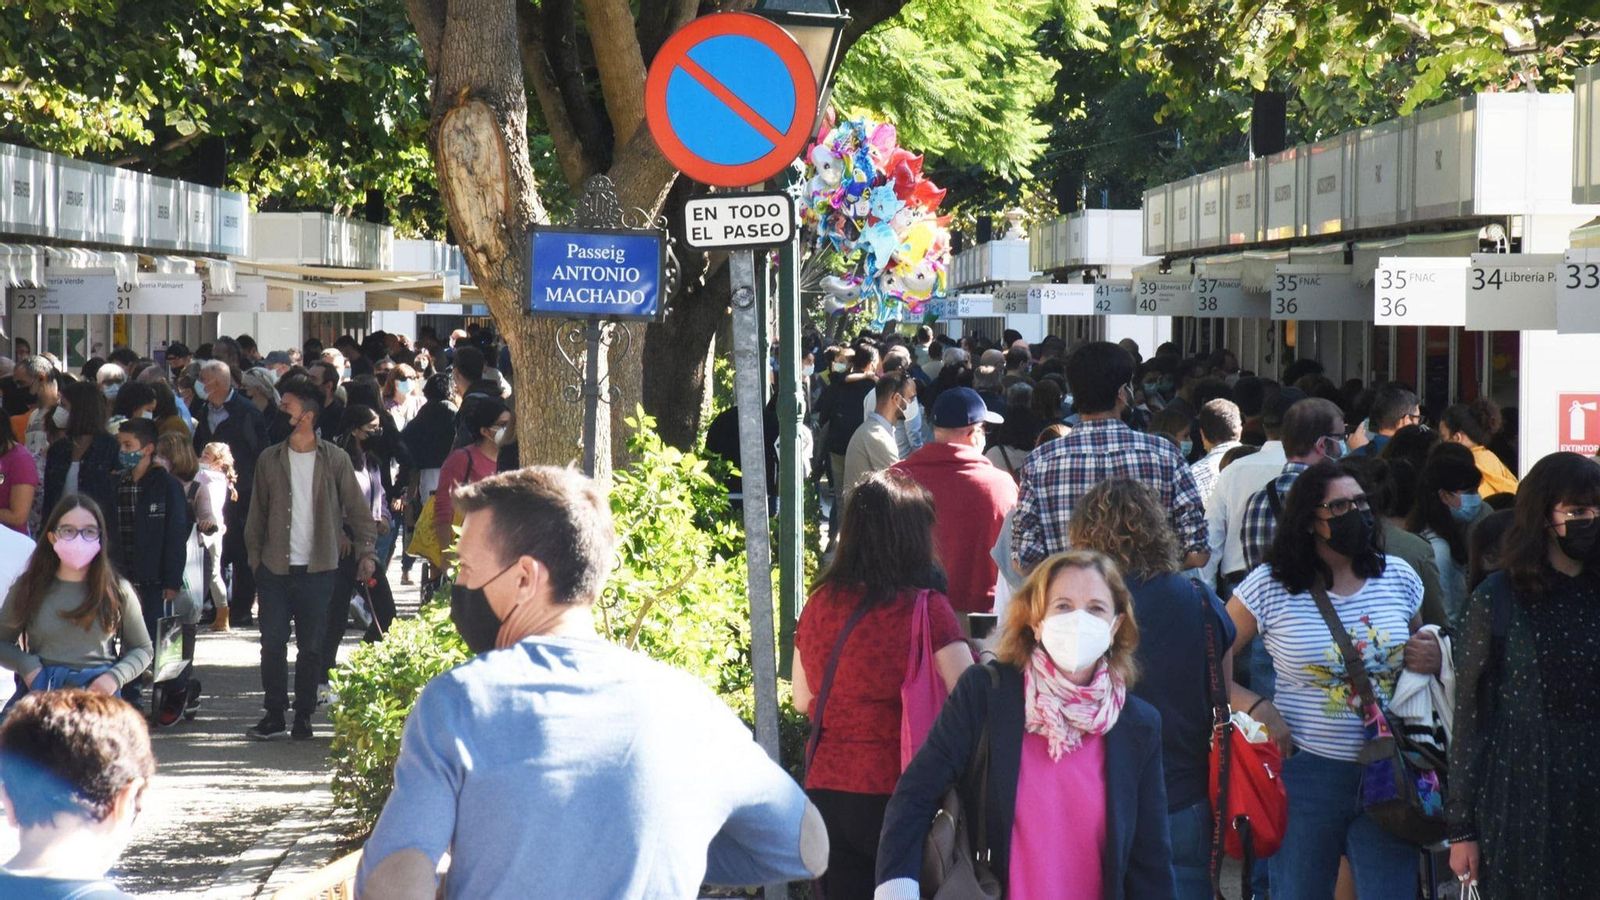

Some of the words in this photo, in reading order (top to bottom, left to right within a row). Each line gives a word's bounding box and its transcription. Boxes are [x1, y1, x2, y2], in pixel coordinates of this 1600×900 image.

[693, 206, 717, 221] EN
[728, 202, 781, 219] TODO
[692, 226, 713, 241] EL
[723, 223, 784, 239] PASEO
[567, 244, 625, 263] Passeig
[551, 265, 640, 283] ANTONIO
[1381, 270, 1407, 290] 35
[1409, 272, 1436, 283] FNAC
[1471, 268, 1503, 290] 34
[1504, 271, 1545, 282] Librería
[1565, 264, 1600, 289] 33
[1096, 285, 1109, 296] 41
[1140, 282, 1157, 295] 39
[1198, 278, 1217, 294] 37
[1276, 274, 1297, 292] 35
[1299, 277, 1321, 286] FNAC
[545, 287, 645, 305] MACHADO
[1005, 291, 1016, 299] 44
[1029, 288, 1042, 299] 43
[1043, 289, 1056, 300] 43
[17, 294, 37, 309] 23
[117, 297, 130, 309] 21
[306, 298, 318, 309] 16
[1005, 302, 1016, 311] 45
[1095, 300, 1112, 311] 42
[1139, 298, 1157, 312] 40
[1198, 296, 1218, 311] 38
[1275, 297, 1298, 314] 36
[1380, 297, 1407, 317] 36
